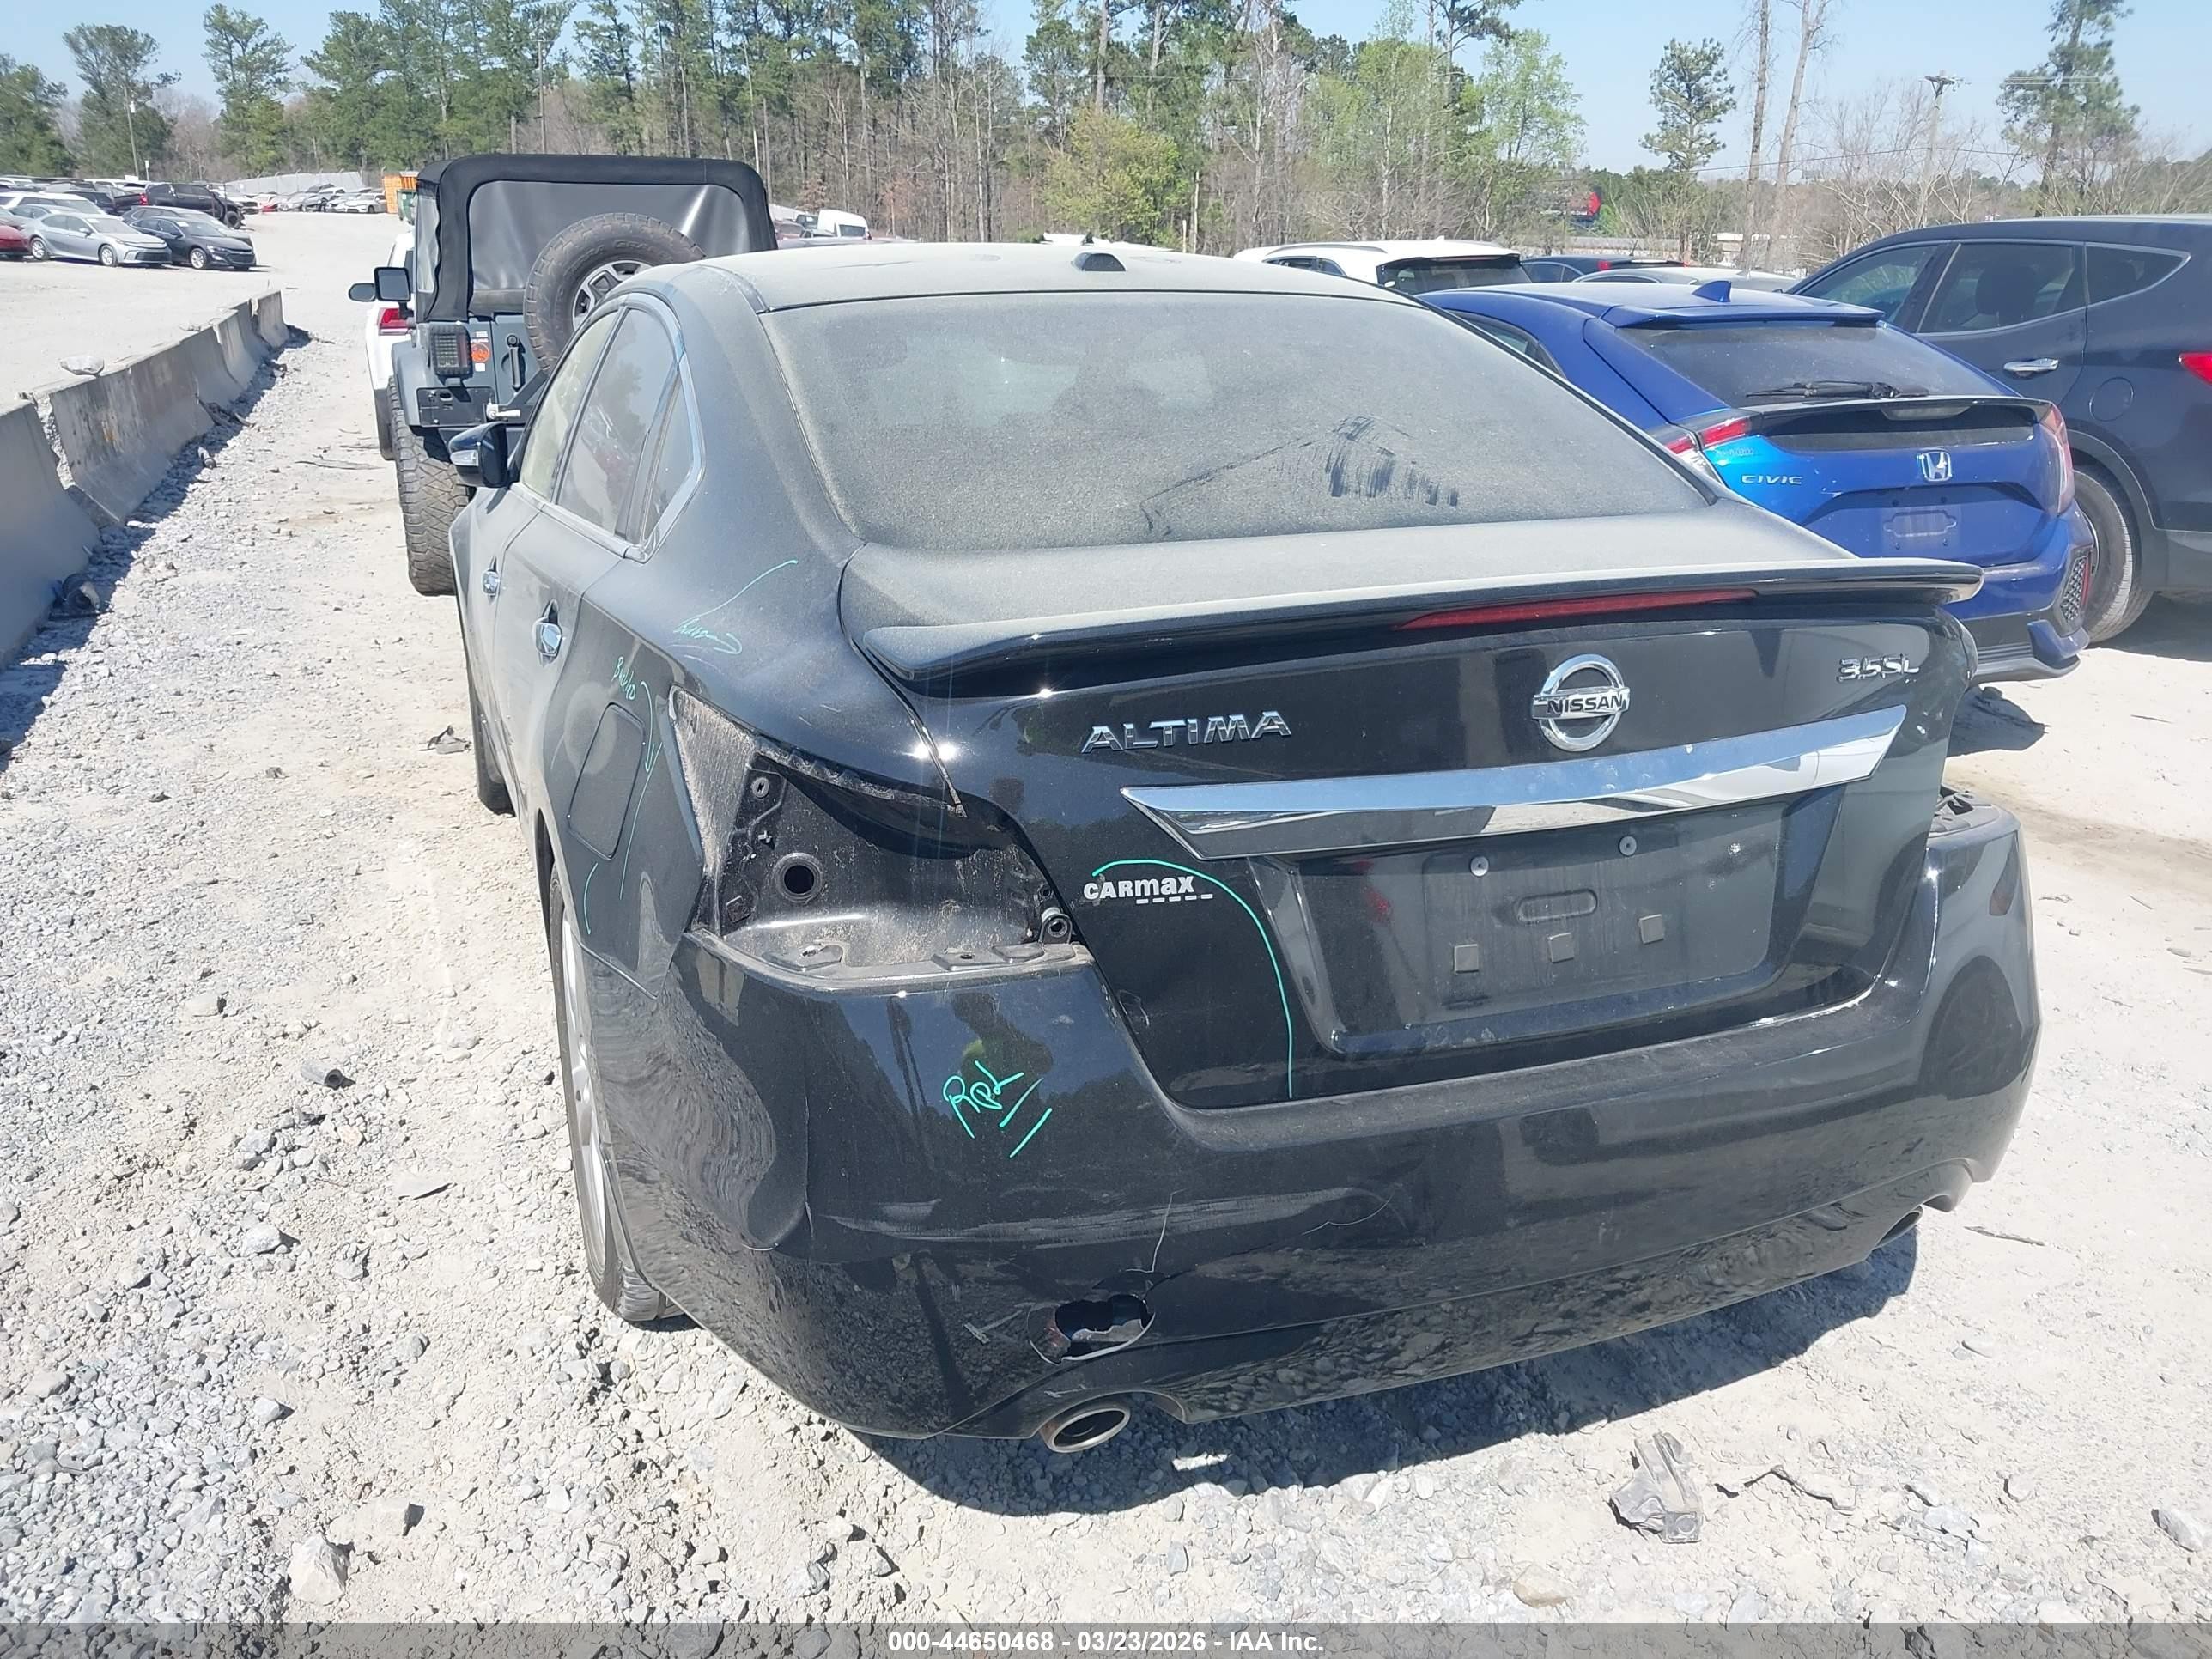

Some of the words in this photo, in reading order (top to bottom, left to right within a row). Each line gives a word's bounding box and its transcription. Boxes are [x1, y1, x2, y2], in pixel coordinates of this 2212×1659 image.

[1741, 474, 1803, 486] CIVIC
[1547, 694, 1623, 714] NISSAN
[1081, 710, 1292, 754] ALTIMA
